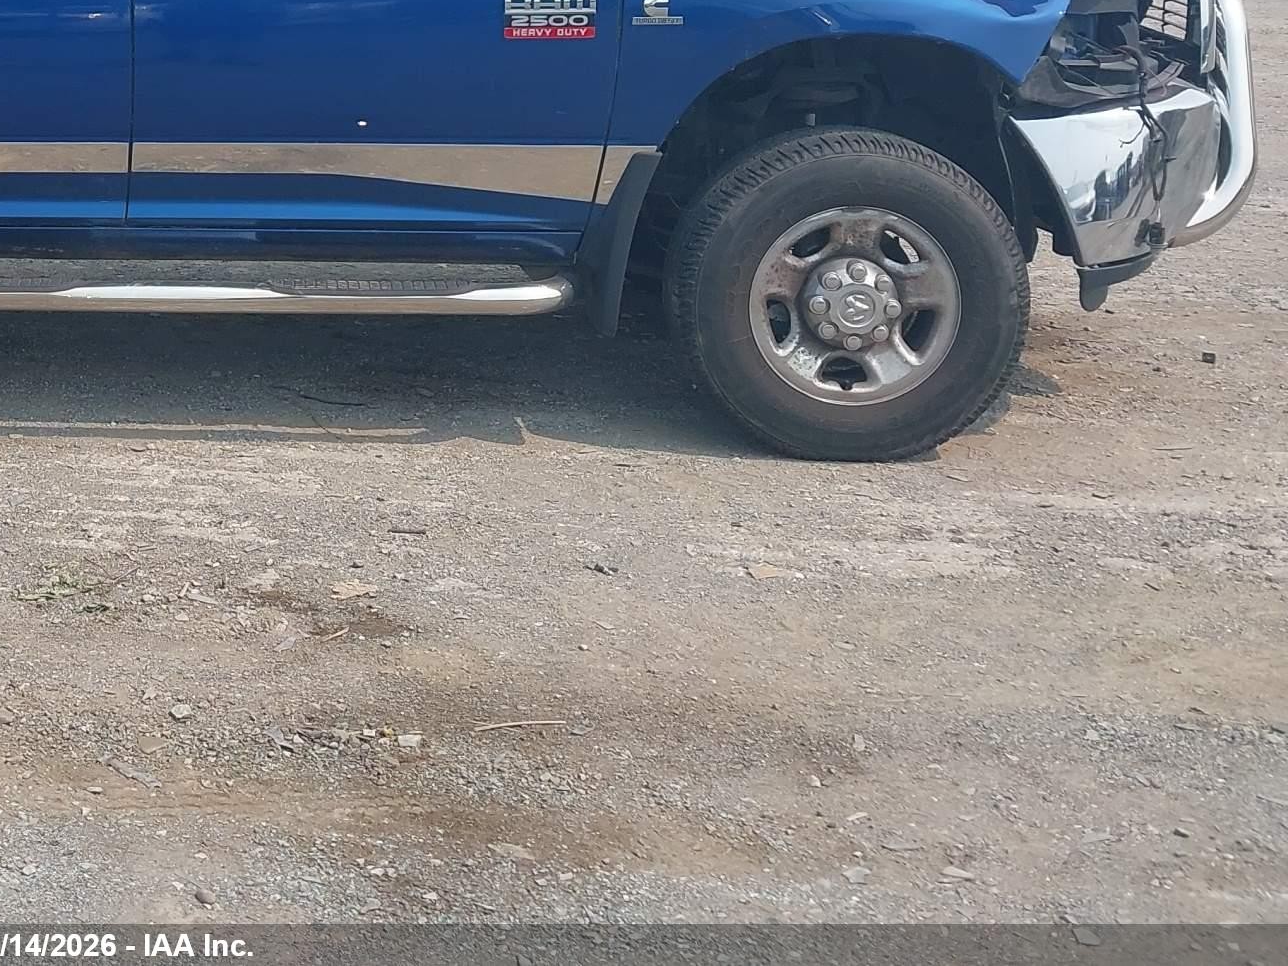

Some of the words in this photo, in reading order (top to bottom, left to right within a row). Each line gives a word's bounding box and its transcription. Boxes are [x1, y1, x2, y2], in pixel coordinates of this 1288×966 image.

[511, 14, 589, 27] 2500
[512, 27, 552, 37] HEAVY
[556, 27, 588, 36] DUTY
